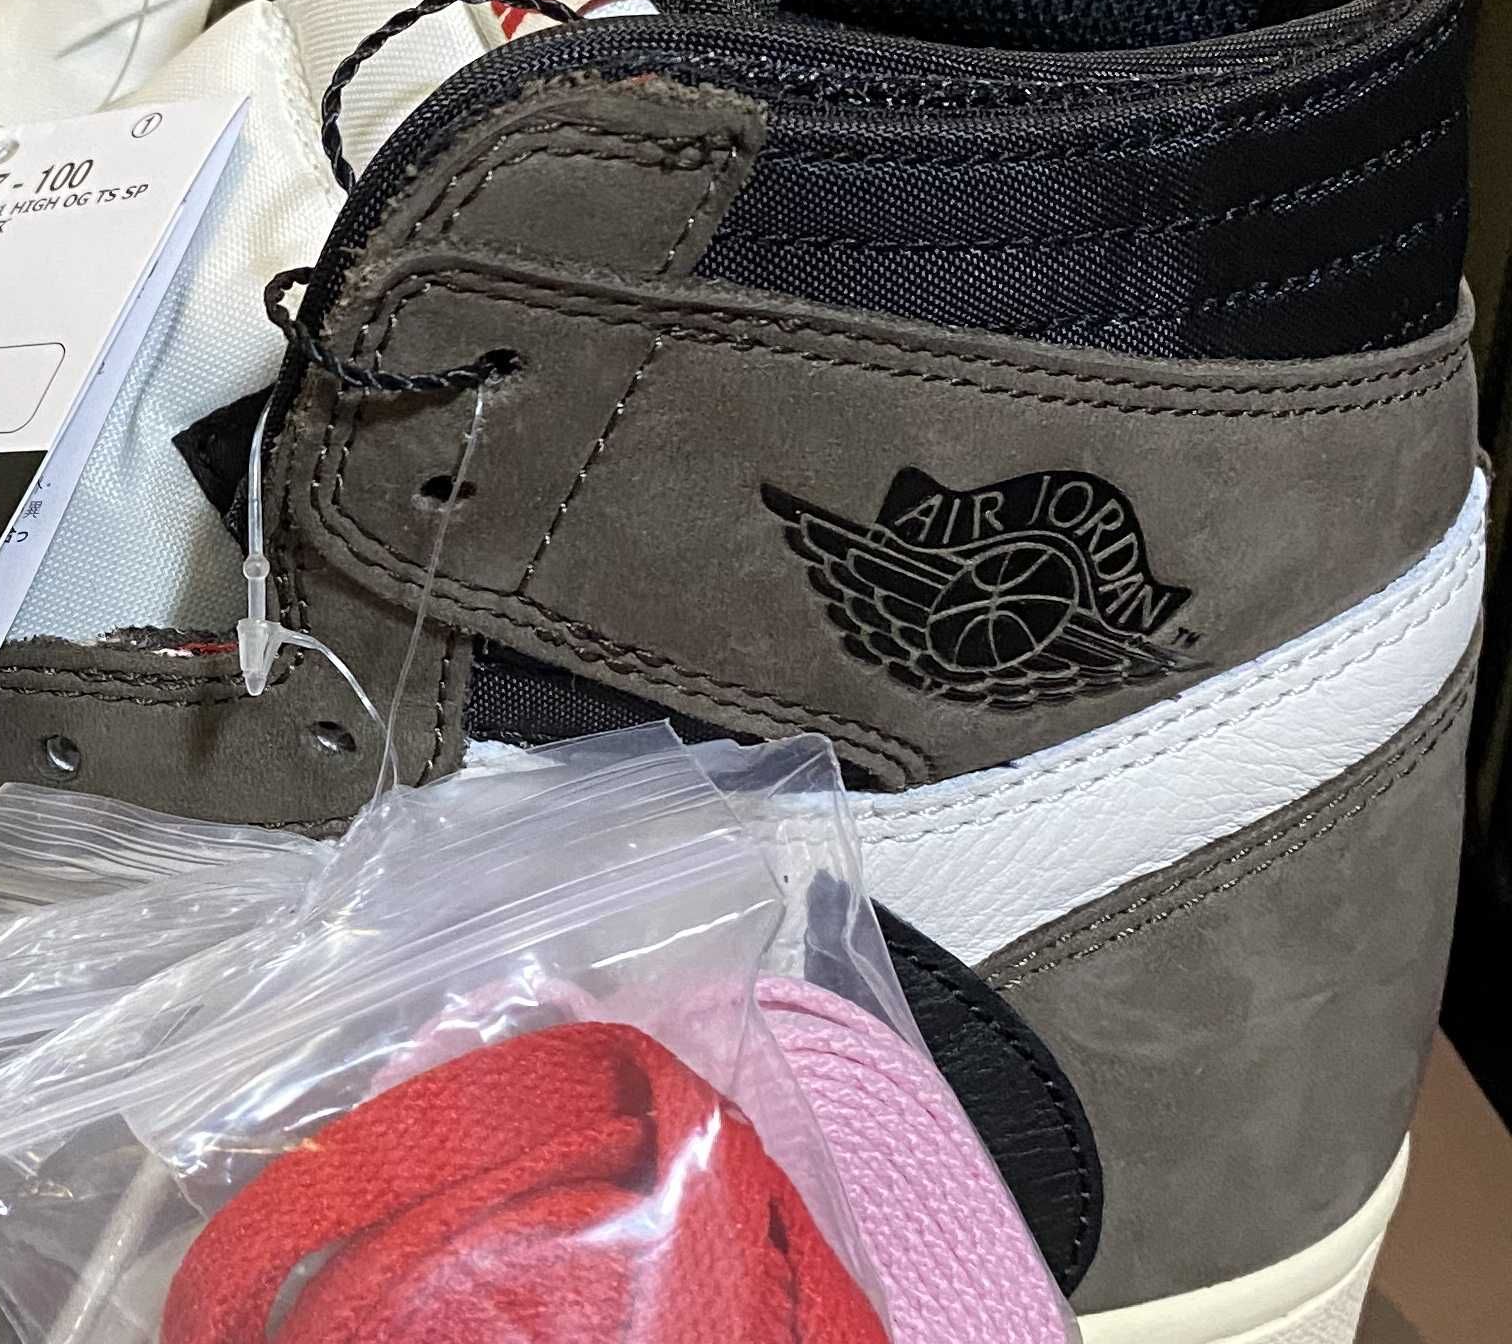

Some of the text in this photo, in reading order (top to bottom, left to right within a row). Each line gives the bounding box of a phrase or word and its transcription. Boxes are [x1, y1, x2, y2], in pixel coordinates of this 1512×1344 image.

[10, 196, 59, 215] HIGH
[63, 192, 92, 208] OG
[96, 188, 120, 204] TS
[122, 184, 149, 200] SP
[895, 474, 1172, 628] AIR JORDAN
